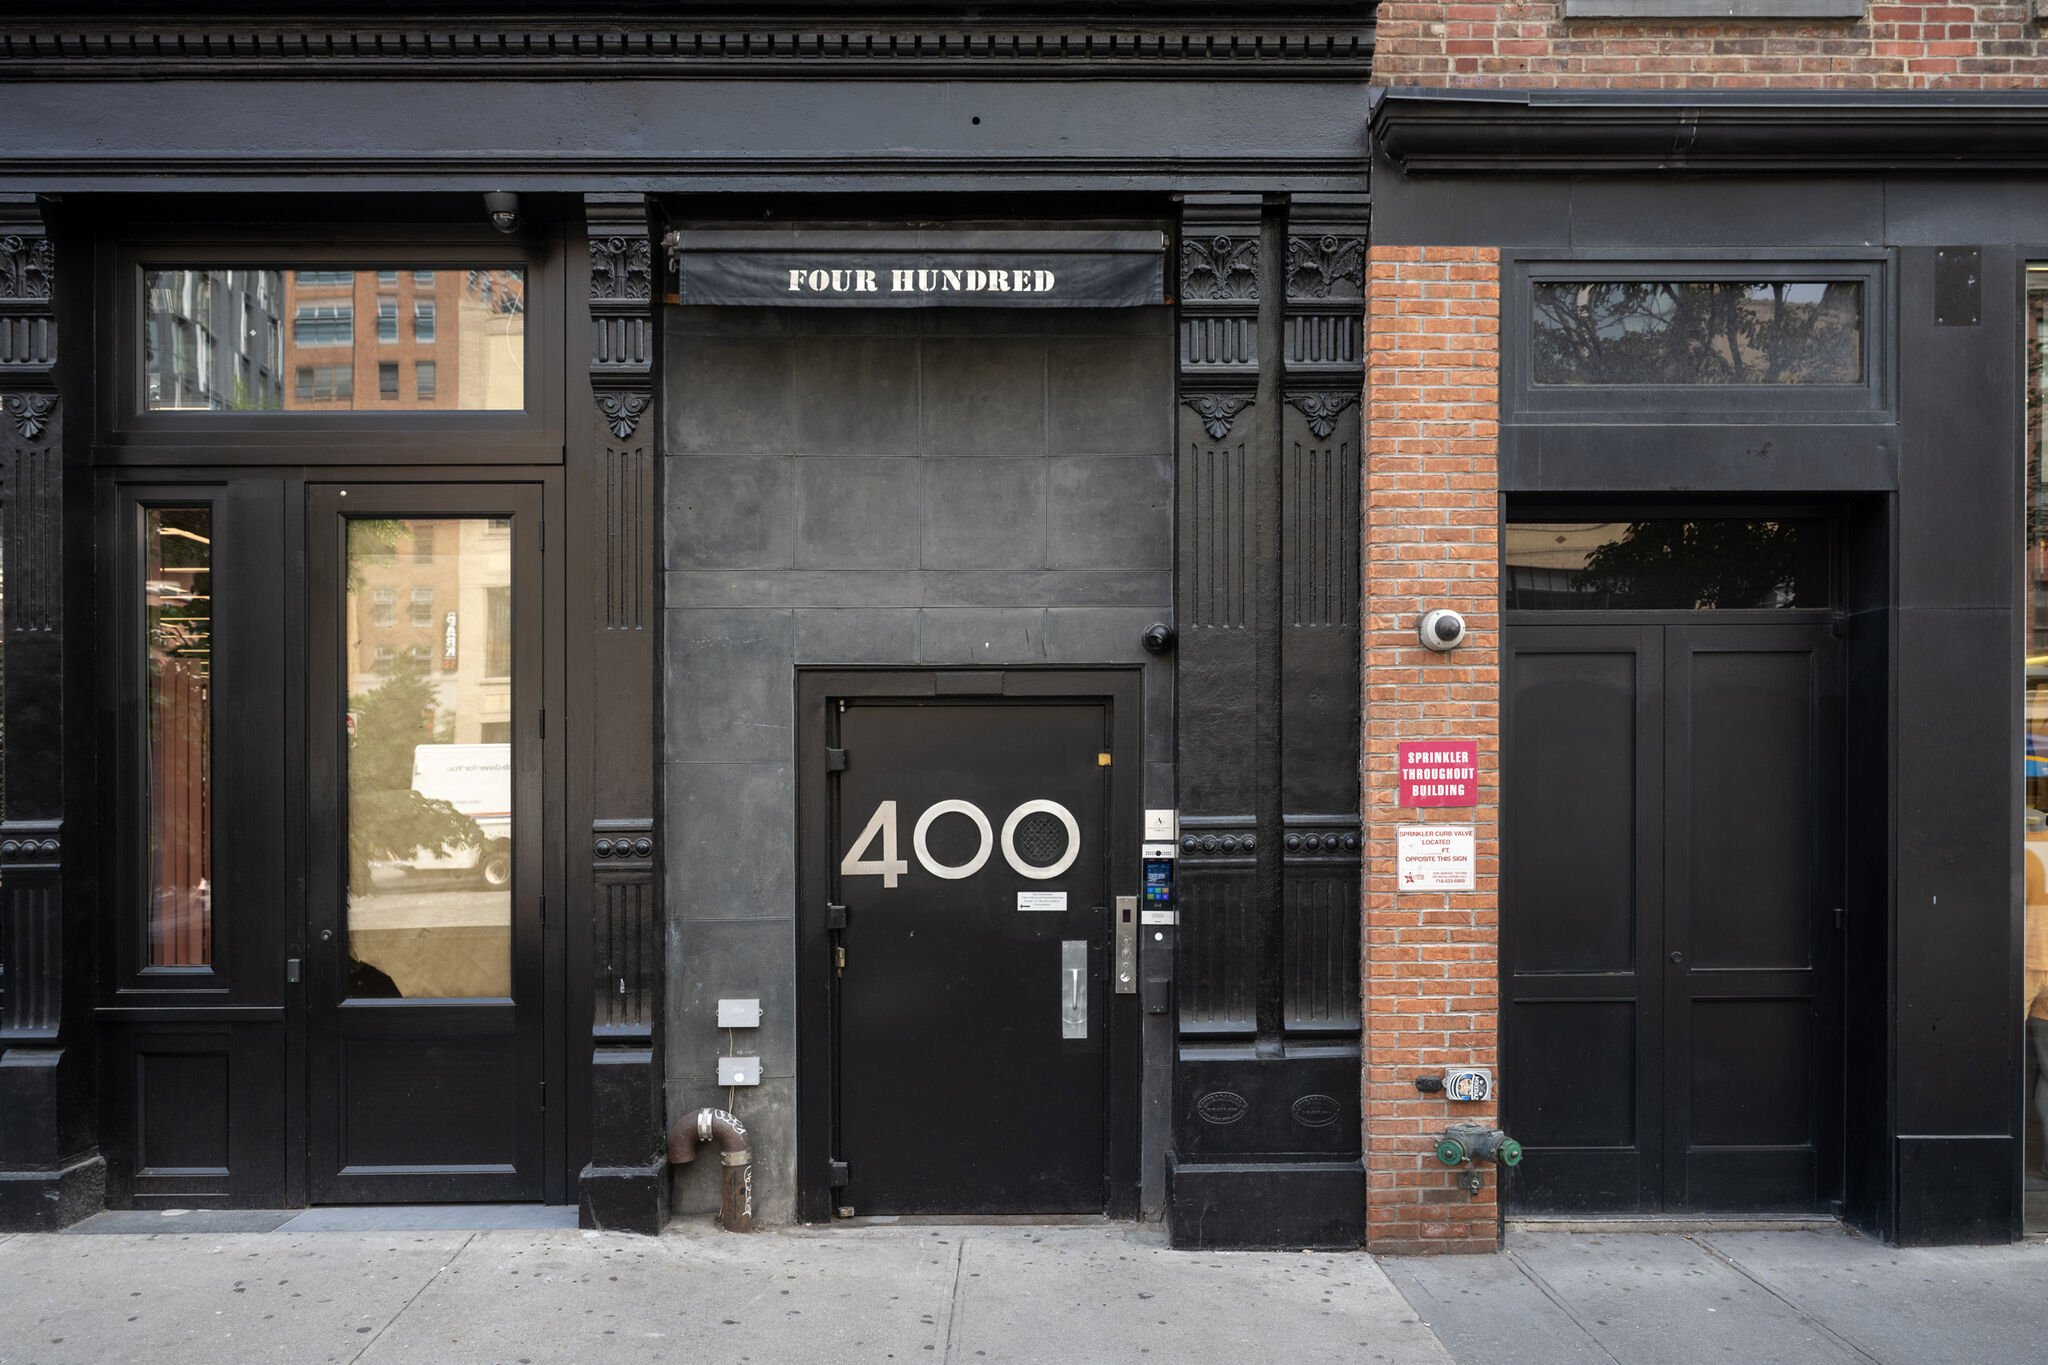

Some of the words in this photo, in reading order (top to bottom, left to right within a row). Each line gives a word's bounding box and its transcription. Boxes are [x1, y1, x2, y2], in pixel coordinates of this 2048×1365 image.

[788, 269, 879, 293] FOUR
[891, 269, 1056, 293] HUNDRED
[1408, 751, 1469, 764] SPRINKLER
[1402, 768, 1475, 780] THROUGHOUT
[1412, 784, 1465, 796] BUILDING
[841, 799, 1080, 888] 400
